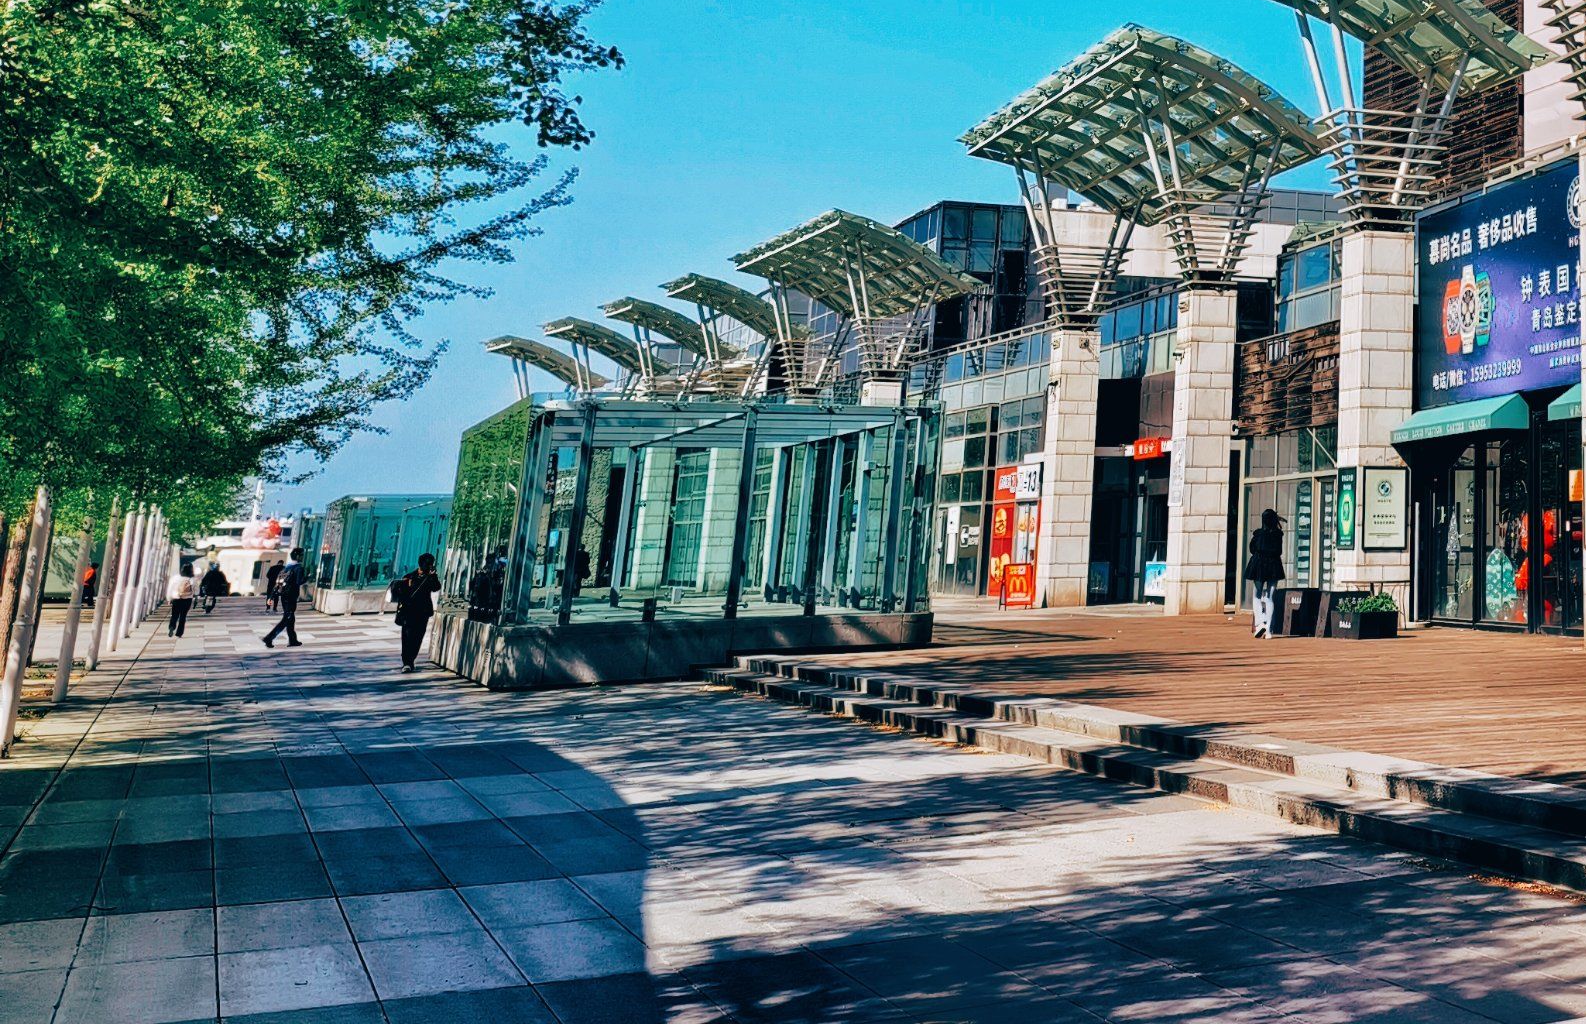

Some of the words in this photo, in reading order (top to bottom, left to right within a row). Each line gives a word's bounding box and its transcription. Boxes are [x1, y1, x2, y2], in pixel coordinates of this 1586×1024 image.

[1429, 228, 1473, 266] 慕尚名品
[1477, 206, 1538, 250] 奢侈品收售
[1531, 299, 1581, 333] 青岛鉴定
